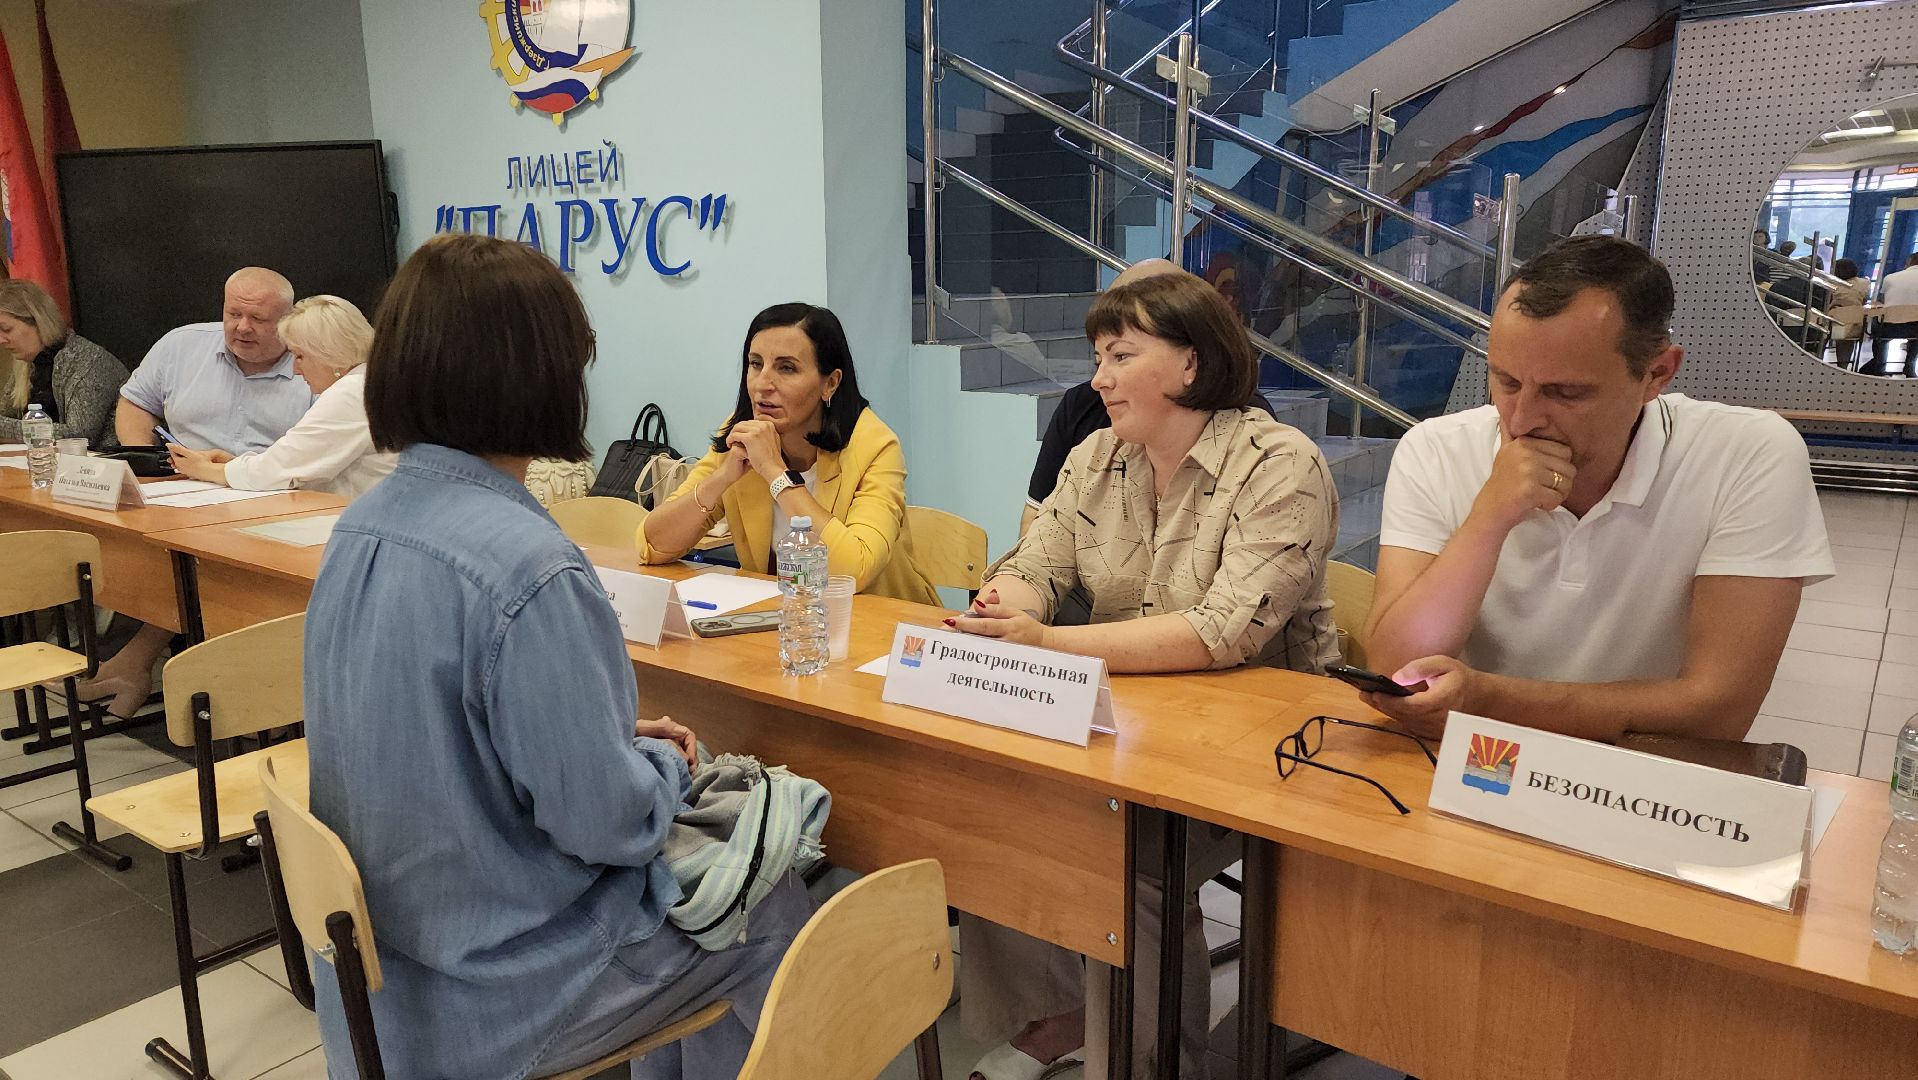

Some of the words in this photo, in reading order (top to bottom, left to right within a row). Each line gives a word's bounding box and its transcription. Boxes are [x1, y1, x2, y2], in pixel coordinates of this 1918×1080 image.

[511, 0, 545, 68] Дзержински
[506, 139, 619, 194] ЛИЦЕЙ
[930, 640, 1089, 685] Градостроительная
[946, 671, 1056, 706] деятельность
[1527, 770, 1751, 845] БЕЗОПАСНОСТЬ
